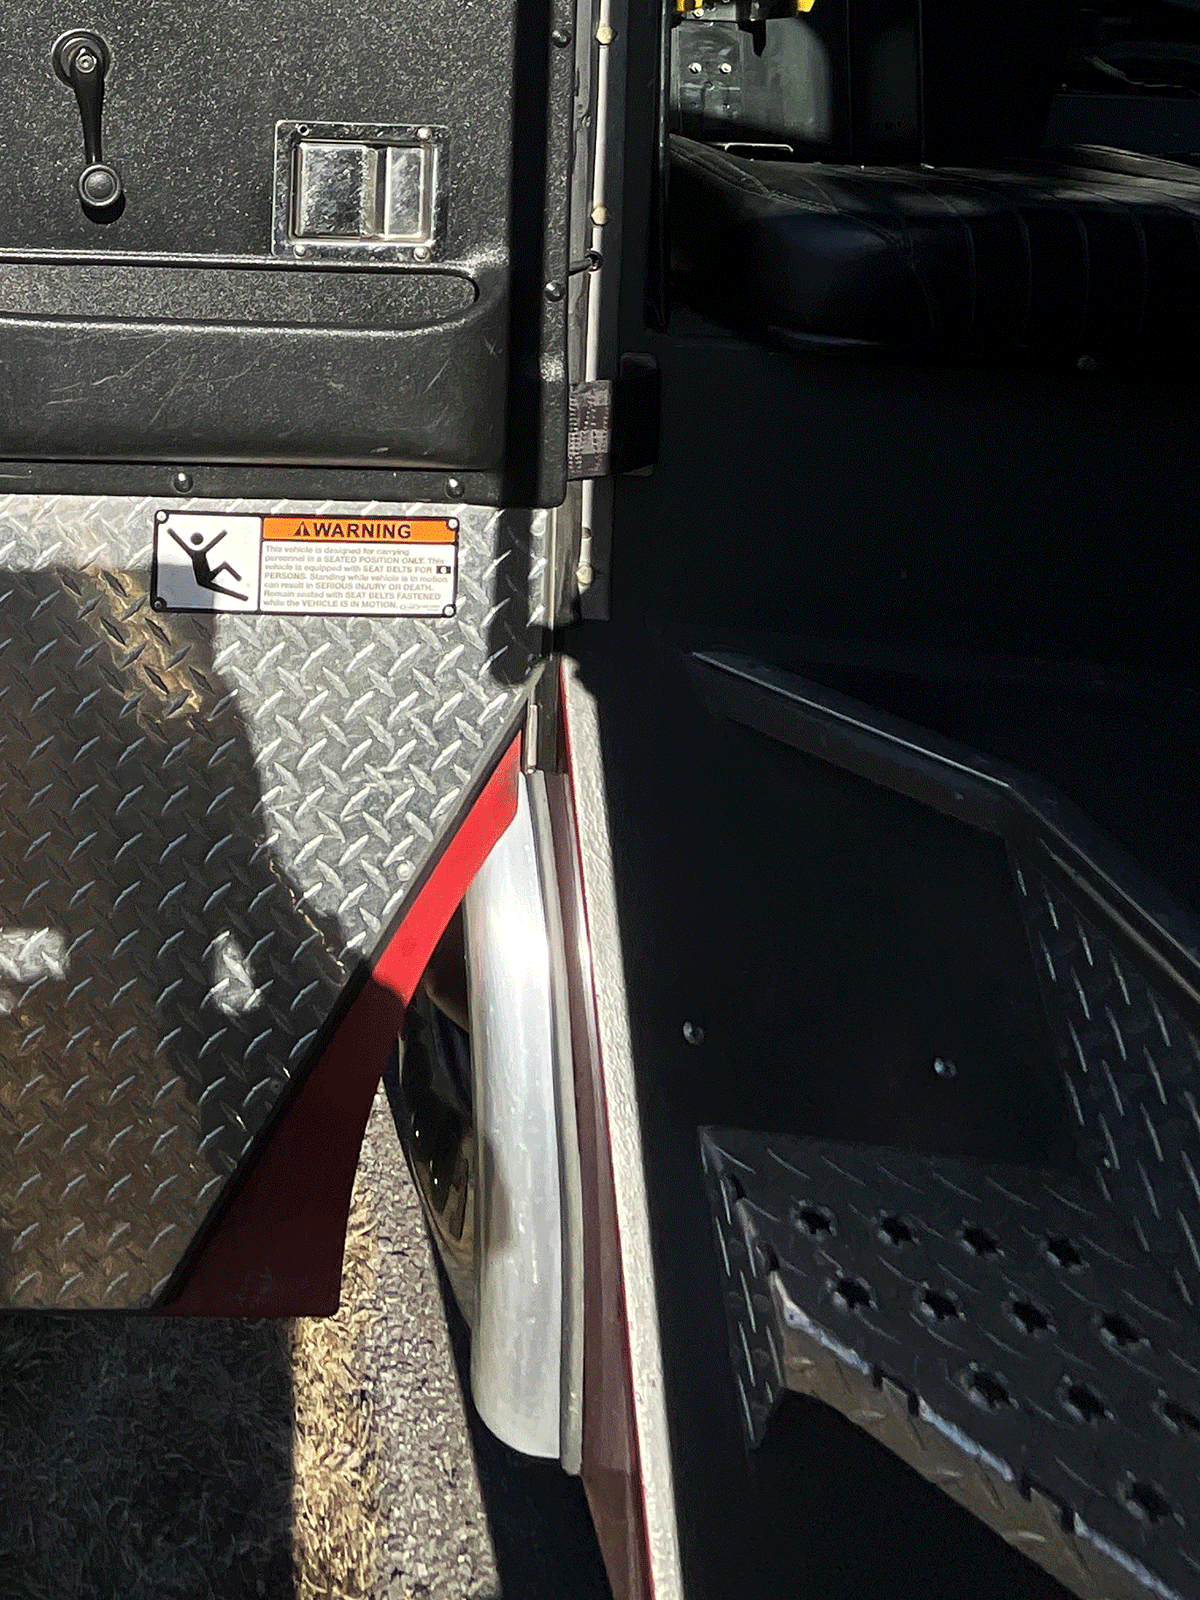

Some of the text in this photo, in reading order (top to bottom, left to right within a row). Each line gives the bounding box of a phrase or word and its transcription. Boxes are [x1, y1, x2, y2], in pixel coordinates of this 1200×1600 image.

[313, 522, 411, 539] WARNING
[324, 547, 361, 555] designed
[265, 555, 305, 563] personnel
[304, 564, 342, 572] equipped
[310, 573, 345, 582] Standing
